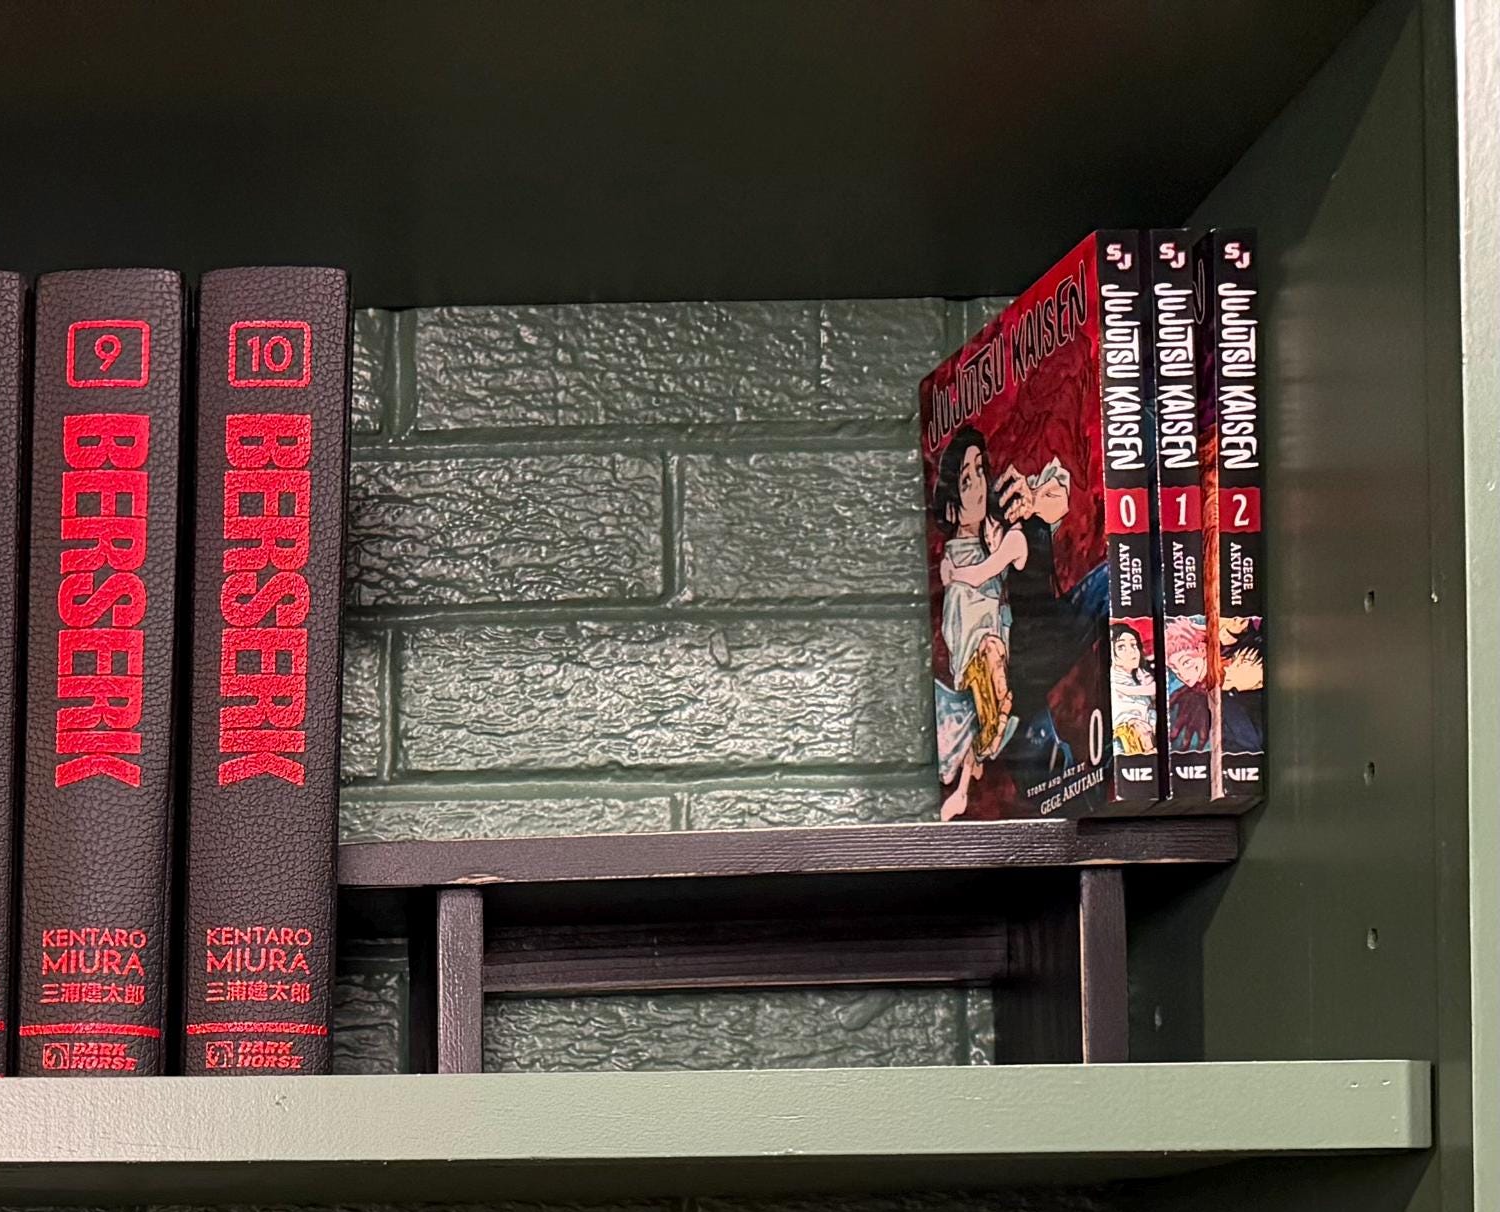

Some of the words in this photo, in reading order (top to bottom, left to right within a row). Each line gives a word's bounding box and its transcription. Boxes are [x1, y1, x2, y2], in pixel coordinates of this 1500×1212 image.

[1101, 283, 1141, 379] JUJUTSU
[1154, 282, 1195, 377] JUJUTSU
[1218, 282, 1258, 378] JUJUTSU
[94, 333, 123, 374] 9
[246, 336, 294, 374] 10
[928, 333, 1006, 452] JUJUTSU
[1010, 259, 1088, 386] KAISEN
[1104, 386, 1146, 470] KAISEN
[1156, 384, 1199, 469] KAISEN
[1218, 385, 1259, 470] KAISEN
[1119, 494, 1137, 528] 0
[1175, 493, 1187, 526] 1
[1232, 493, 1250, 527] 2
[1118, 542, 1132, 607] AKUTAMI
[1131, 558, 1143, 591] GEGE
[1172, 541, 1186, 605] AKUTAMI
[1185, 556, 1197, 589] GEGE
[1230, 542, 1242, 606] AKUTAMI
[1243, 557, 1254, 590] GEGE
[54, 412, 152, 789] BERSERK
[217, 412, 313, 788] BERSERK
[1088, 708, 1103, 766] 0
[1026, 783, 1047, 798] STORY
[1048, 776, 1061, 788] AND
[1063, 767, 1076, 780] ART
[1040, 792, 1062, 815] GEGE
[1062, 768, 1104, 802] AKUTAMI
[1121, 767, 1153, 781] VIZ
[1175, 766, 1207, 780] VIZ
[1227, 767, 1260, 781] VIZ
[42, 928, 148, 948] KENTARO
[206, 926, 313, 948] KENTARO
[41, 948, 145, 977] MIURA
[206, 948, 309, 975] MIURA
